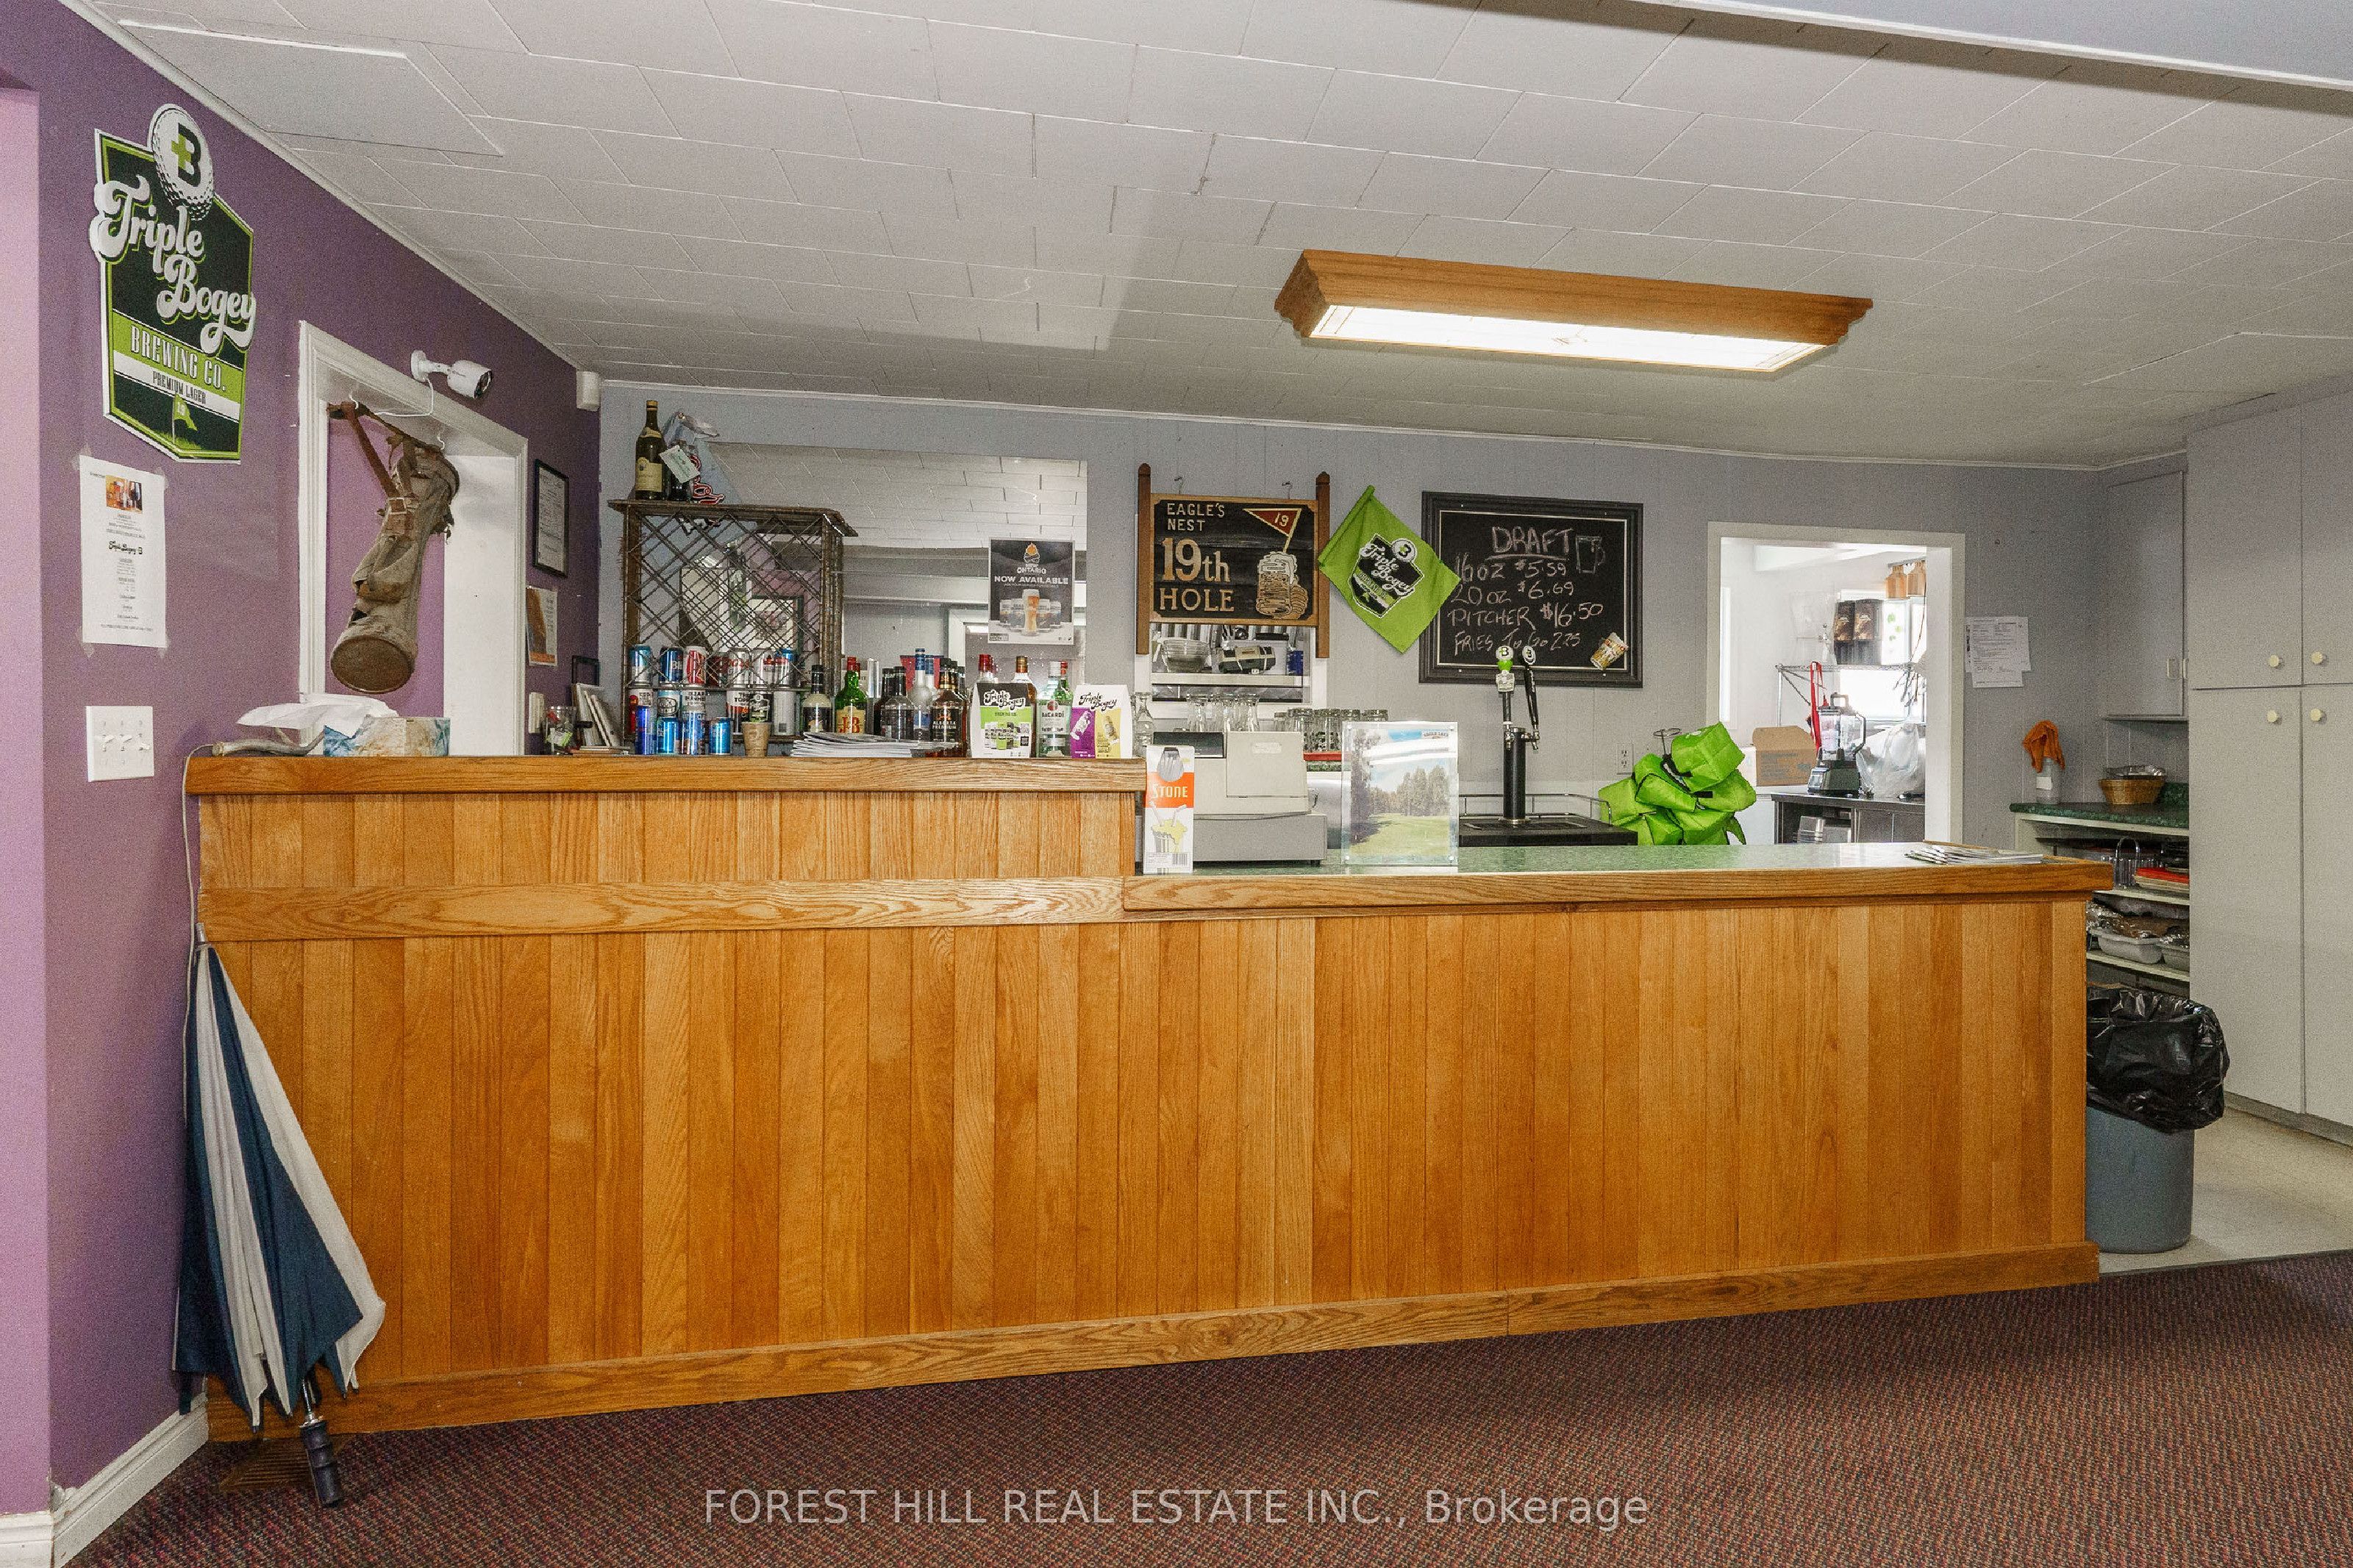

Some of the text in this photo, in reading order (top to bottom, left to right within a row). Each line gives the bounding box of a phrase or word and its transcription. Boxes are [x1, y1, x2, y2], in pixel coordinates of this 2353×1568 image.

[93, 174, 204, 273] Triple
[156, 254, 256, 354] Bogey
[131, 324, 227, 392] BREWING CO.
[152, 370, 206, 404] PREMIUM LAGER
[1167, 503, 1225, 518] EAGLE'S
[1274, 512, 1289, 527] 19
[1167, 518, 1205, 531] NEST
[1492, 526, 1574, 555] DRAFT
[1162, 537, 1231, 582] 19th
[1515, 559, 1566, 579] $5.59
[1019, 576, 1069, 584] AVAILABLE
[1517, 580, 1574, 599] $6.69
[1160, 587, 1235, 612] HOLE
[1447, 601, 1604, 630] PITCHER $16.50
[1454, 630, 1493, 656] FRIES
[985, 690, 1008, 704] Triple
[999, 698, 1024, 711] Bogey
[1079, 692, 1102, 705] Triple
[1091, 699, 1117, 712] Bogey
